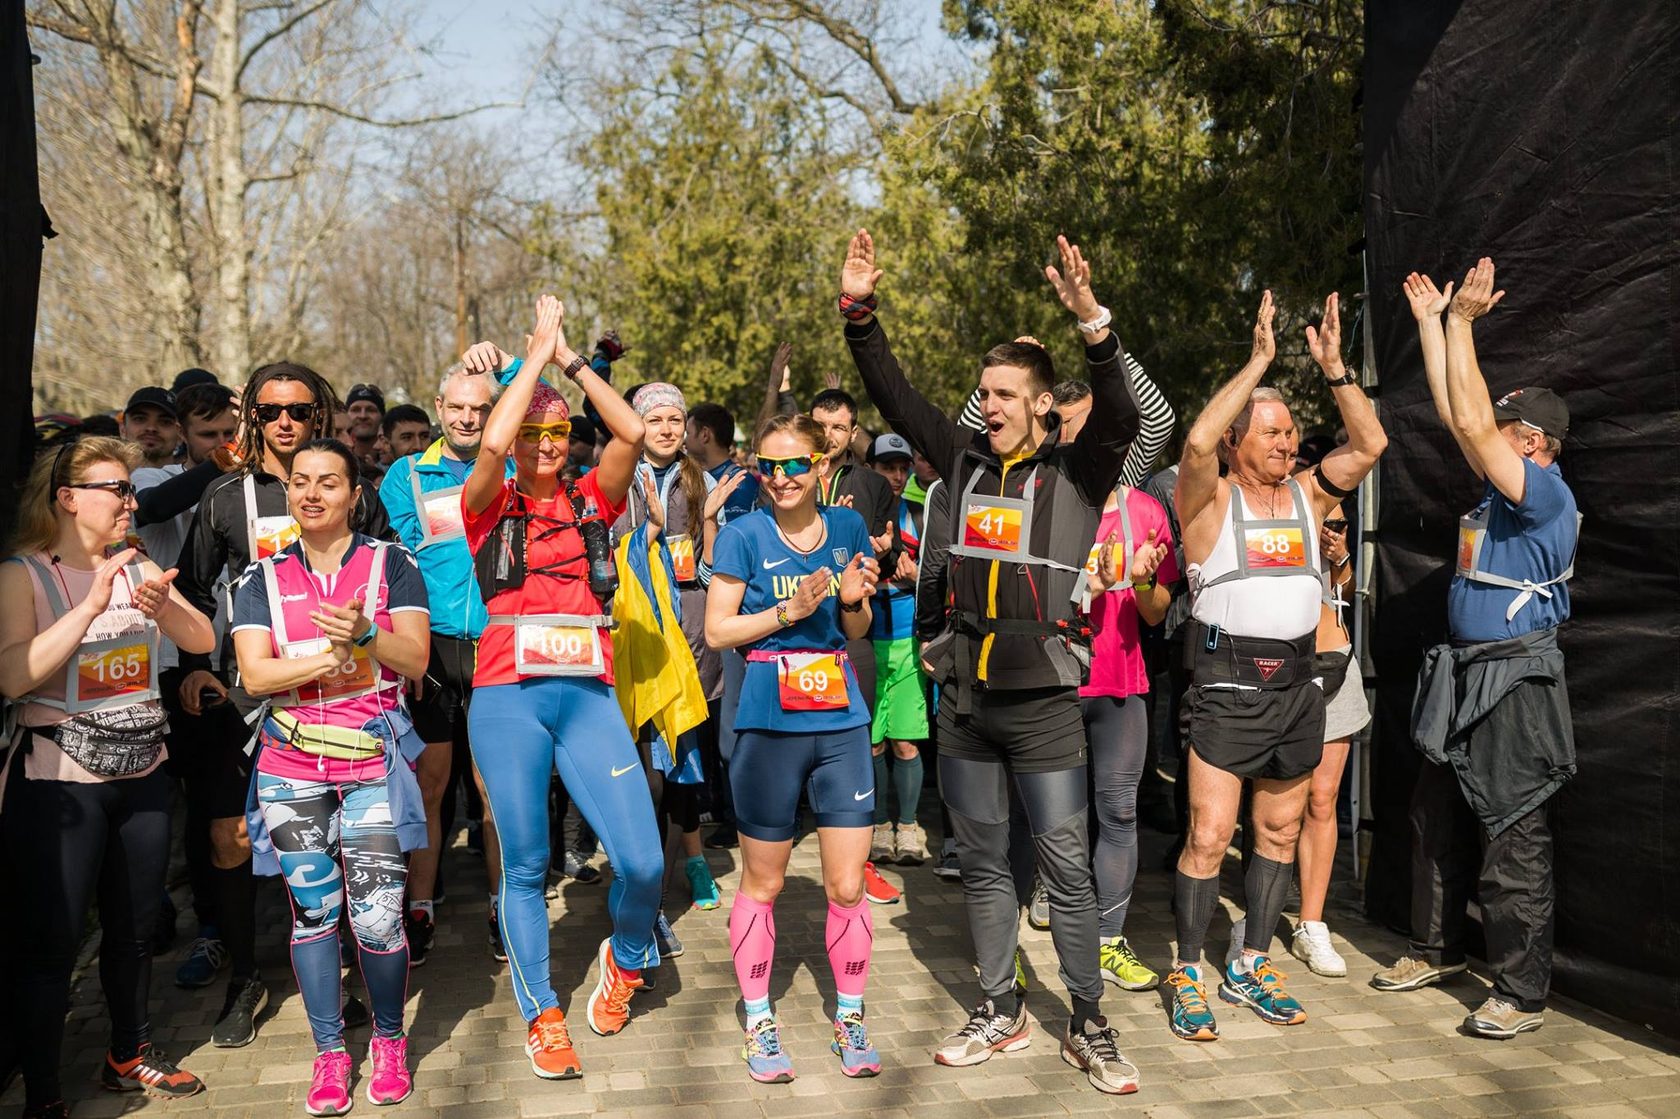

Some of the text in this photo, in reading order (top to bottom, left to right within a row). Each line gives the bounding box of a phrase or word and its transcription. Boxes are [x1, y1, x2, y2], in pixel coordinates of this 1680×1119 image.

[978, 513, 1005, 536] 41
[1262, 534, 1290, 554] 88
[95, 631, 112, 641] HOW
[541, 634, 581, 657] 100
[92, 653, 141, 682] 165
[799, 670, 829, 692] 69
